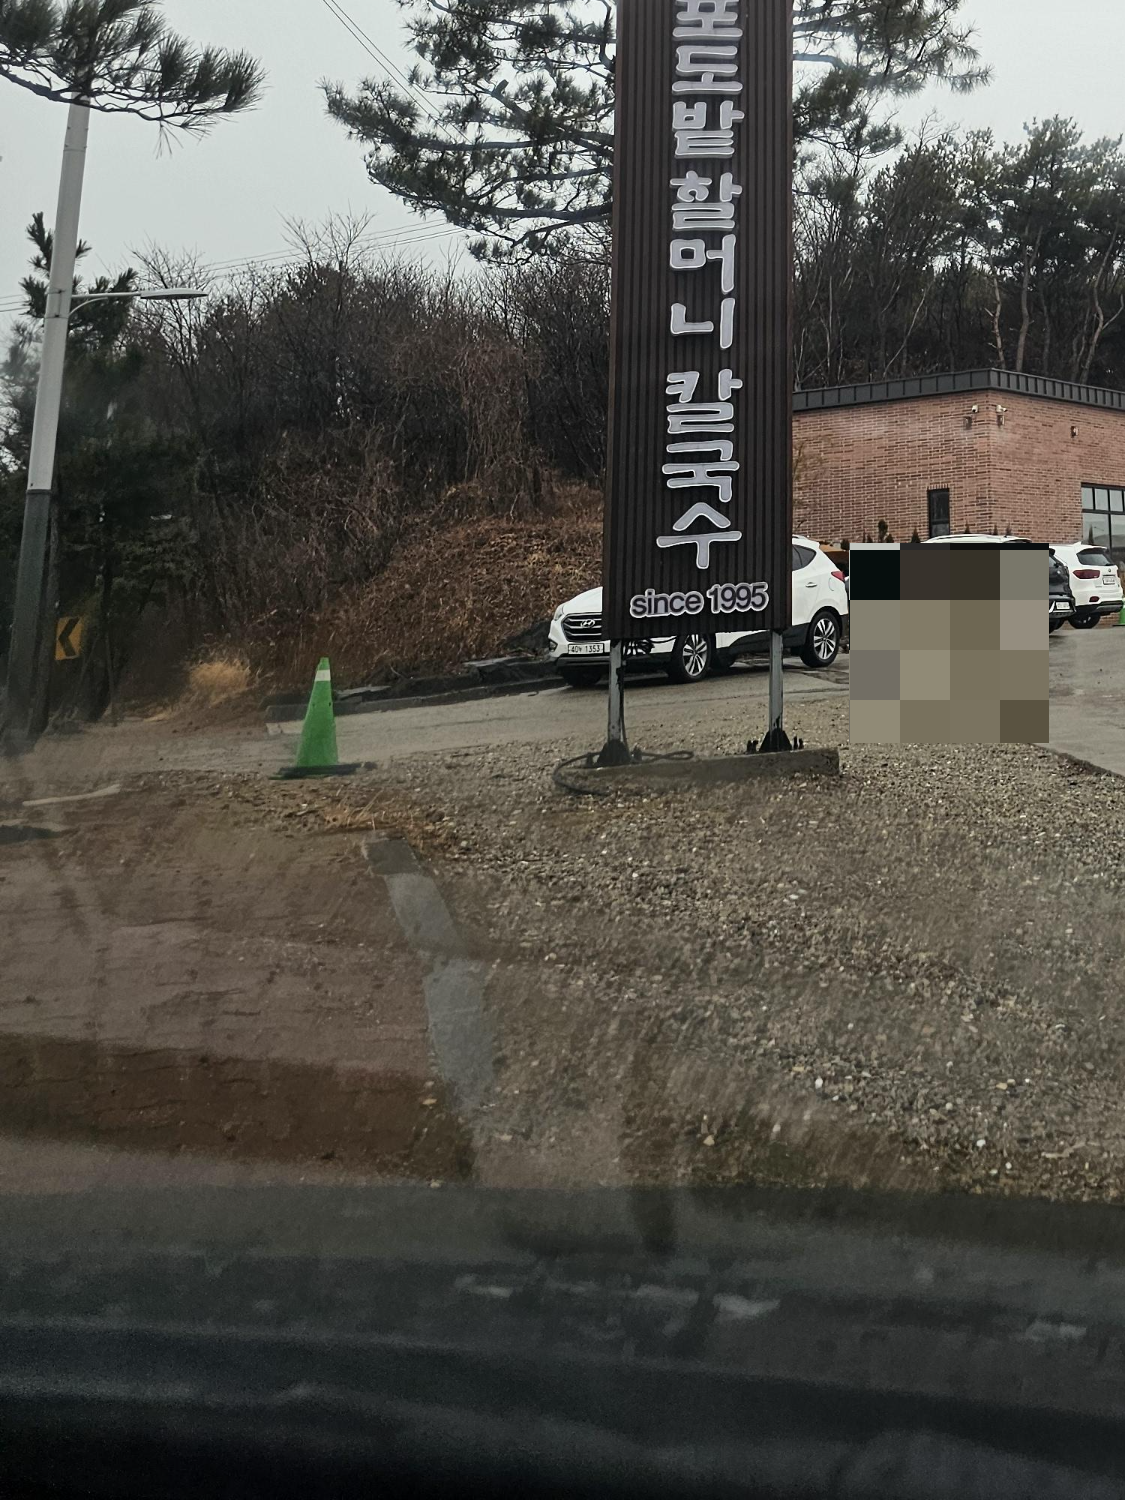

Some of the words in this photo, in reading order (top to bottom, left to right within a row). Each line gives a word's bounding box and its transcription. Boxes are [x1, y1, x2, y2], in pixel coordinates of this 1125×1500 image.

[669, 171, 743, 349] 할머니
[656, 369, 743, 570] 칼국수
[630, 588, 704, 618] since
[706, 582, 769, 614] 1995
